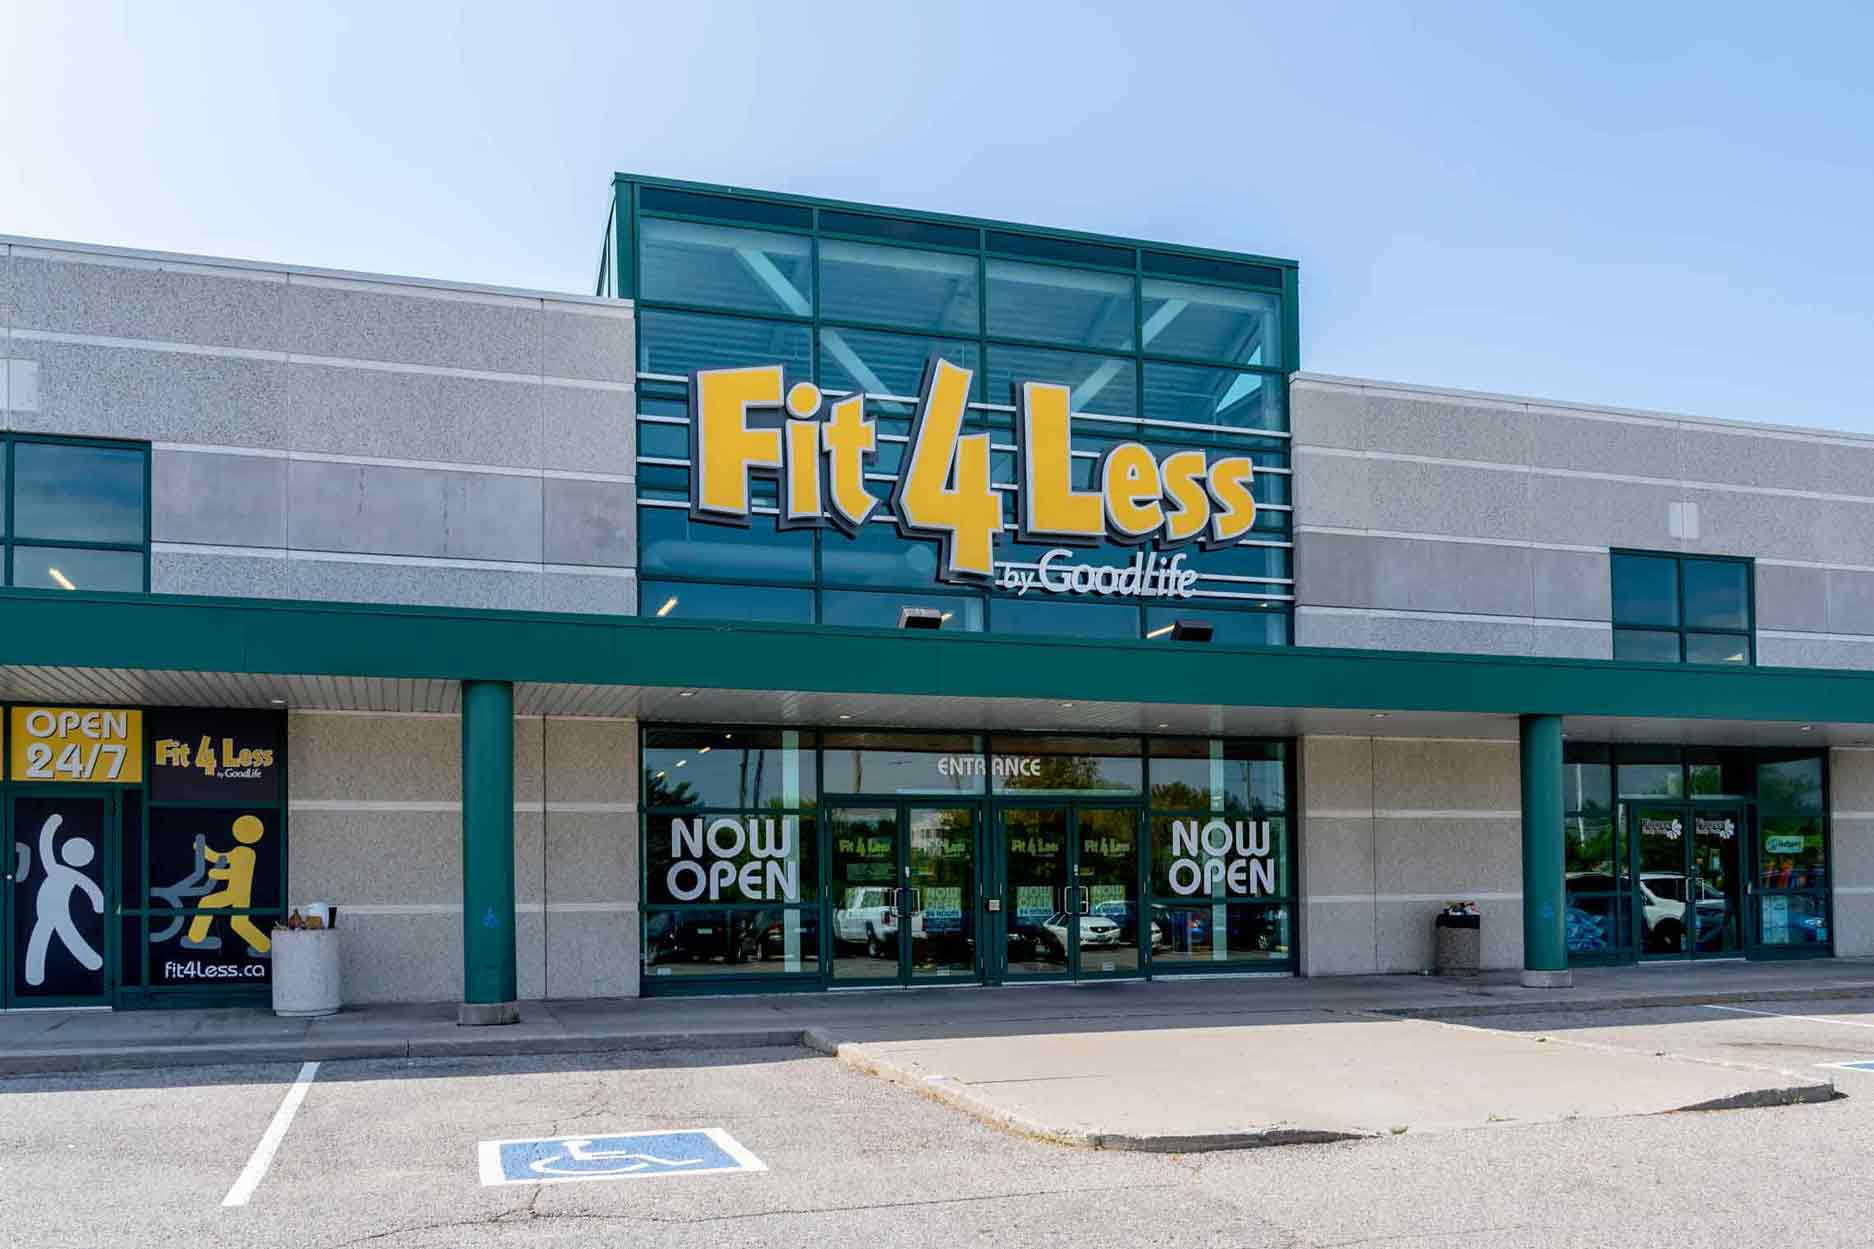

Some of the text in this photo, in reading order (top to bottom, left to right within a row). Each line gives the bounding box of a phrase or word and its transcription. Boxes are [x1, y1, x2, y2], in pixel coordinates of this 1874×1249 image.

[691, 356, 1257, 578] Fit 4 Less
[1004, 548, 1200, 598] by GoodLife
[26, 710, 128, 739] OPEN
[26, 743, 128, 780] 24/7
[155, 735, 274, 776] Fit 4 Less
[224, 767, 262, 779] GoodLife
[937, 756, 1041, 776] ENTRANCE
[671, 817, 792, 859] NOW
[1172, 820, 1271, 858] NOW
[666, 860, 798, 901] OPEN
[1168, 858, 1276, 896] OPEN
[164, 961, 266, 979] fit4Less.ca
